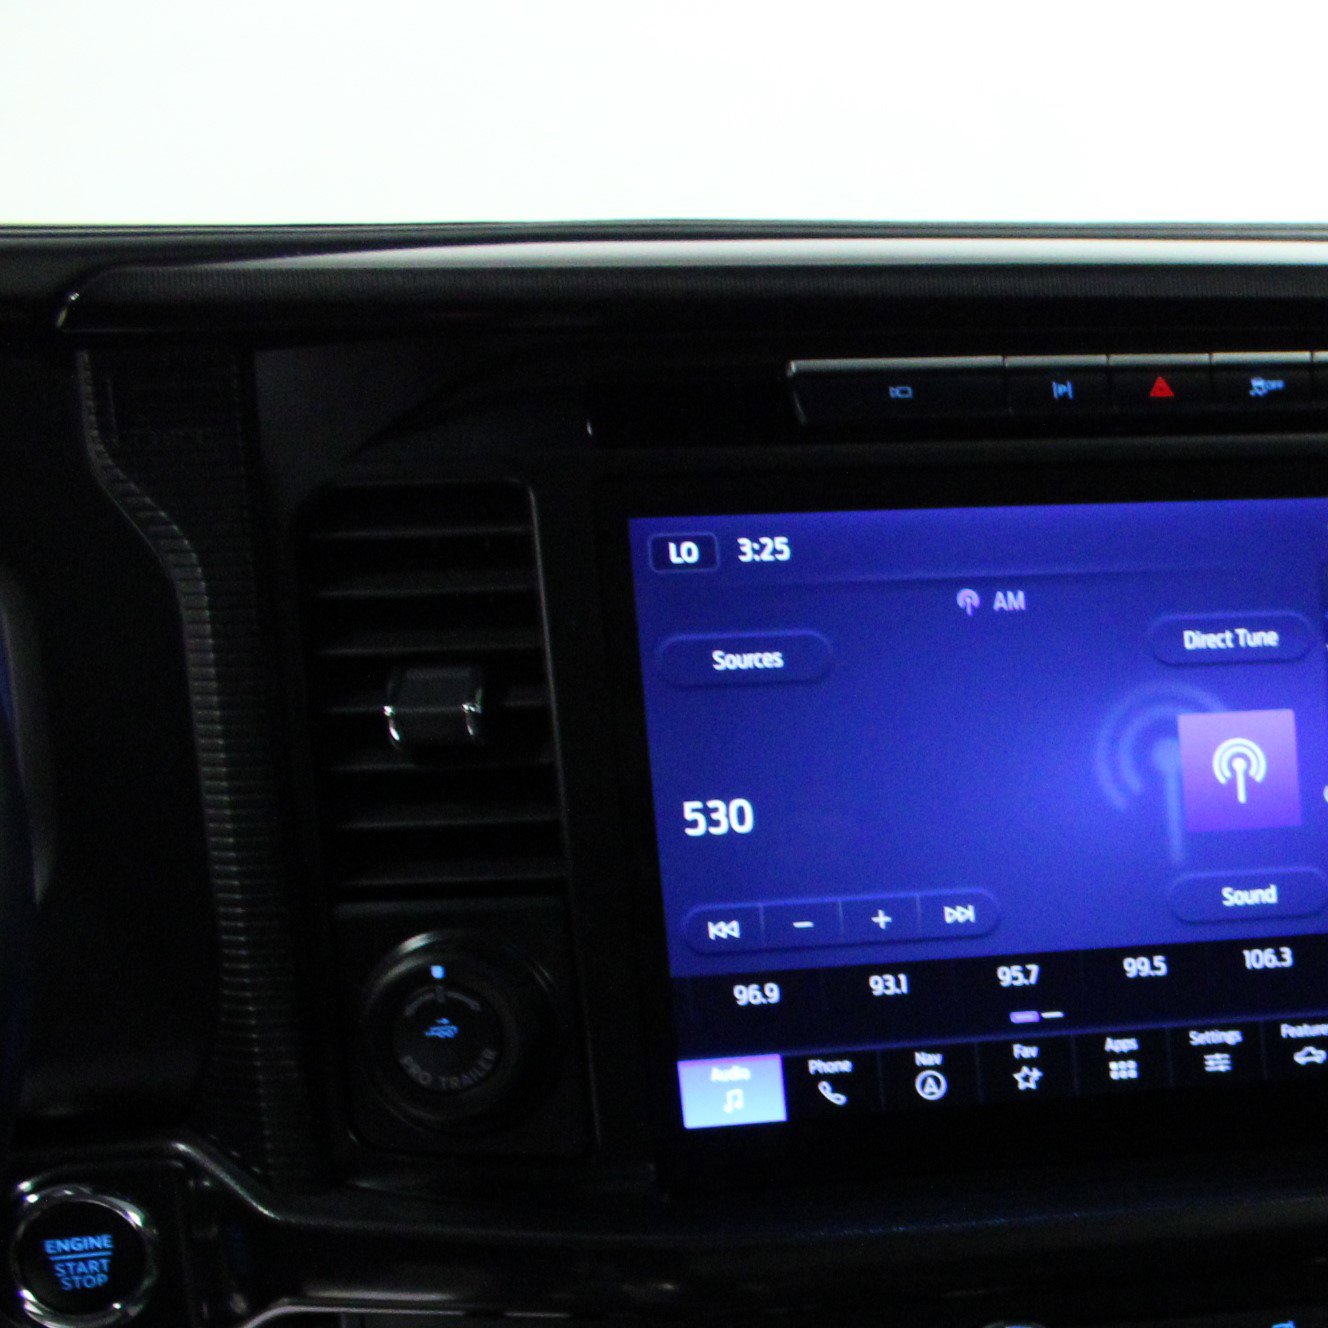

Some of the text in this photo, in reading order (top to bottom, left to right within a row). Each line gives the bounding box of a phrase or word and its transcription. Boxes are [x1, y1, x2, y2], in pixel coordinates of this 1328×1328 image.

[668, 541, 699, 564] LO
[738, 535, 790, 562] 3:25
[993, 591, 1026, 611] AM
[1184, 627, 1279, 651] Direct Tune
[712, 649, 784, 670] Sources
[683, 798, 754, 836] 530
[1222, 884, 1277, 907] Sound
[1123, 955, 1168, 979] 99.5
[1242, 947, 1294, 971] 106.3
[869, 973, 909, 996] 93.1
[997, 963, 1040, 988] 95.7
[733, 982, 780, 1006] 96.9
[1105, 1037, 1138, 1054] Apps
[1189, 1029, 1243, 1046] Settings
[915, 1051, 943, 1067] Nav
[1012, 1043, 1039, 1060] Fav
[710, 1065, 751, 1083] Audio
[808, 1058, 852, 1075] Phone
[44, 1234, 112, 1254] ENGINE
[54, 1258, 111, 1278] START
[60, 1273, 108, 1291] STOP
